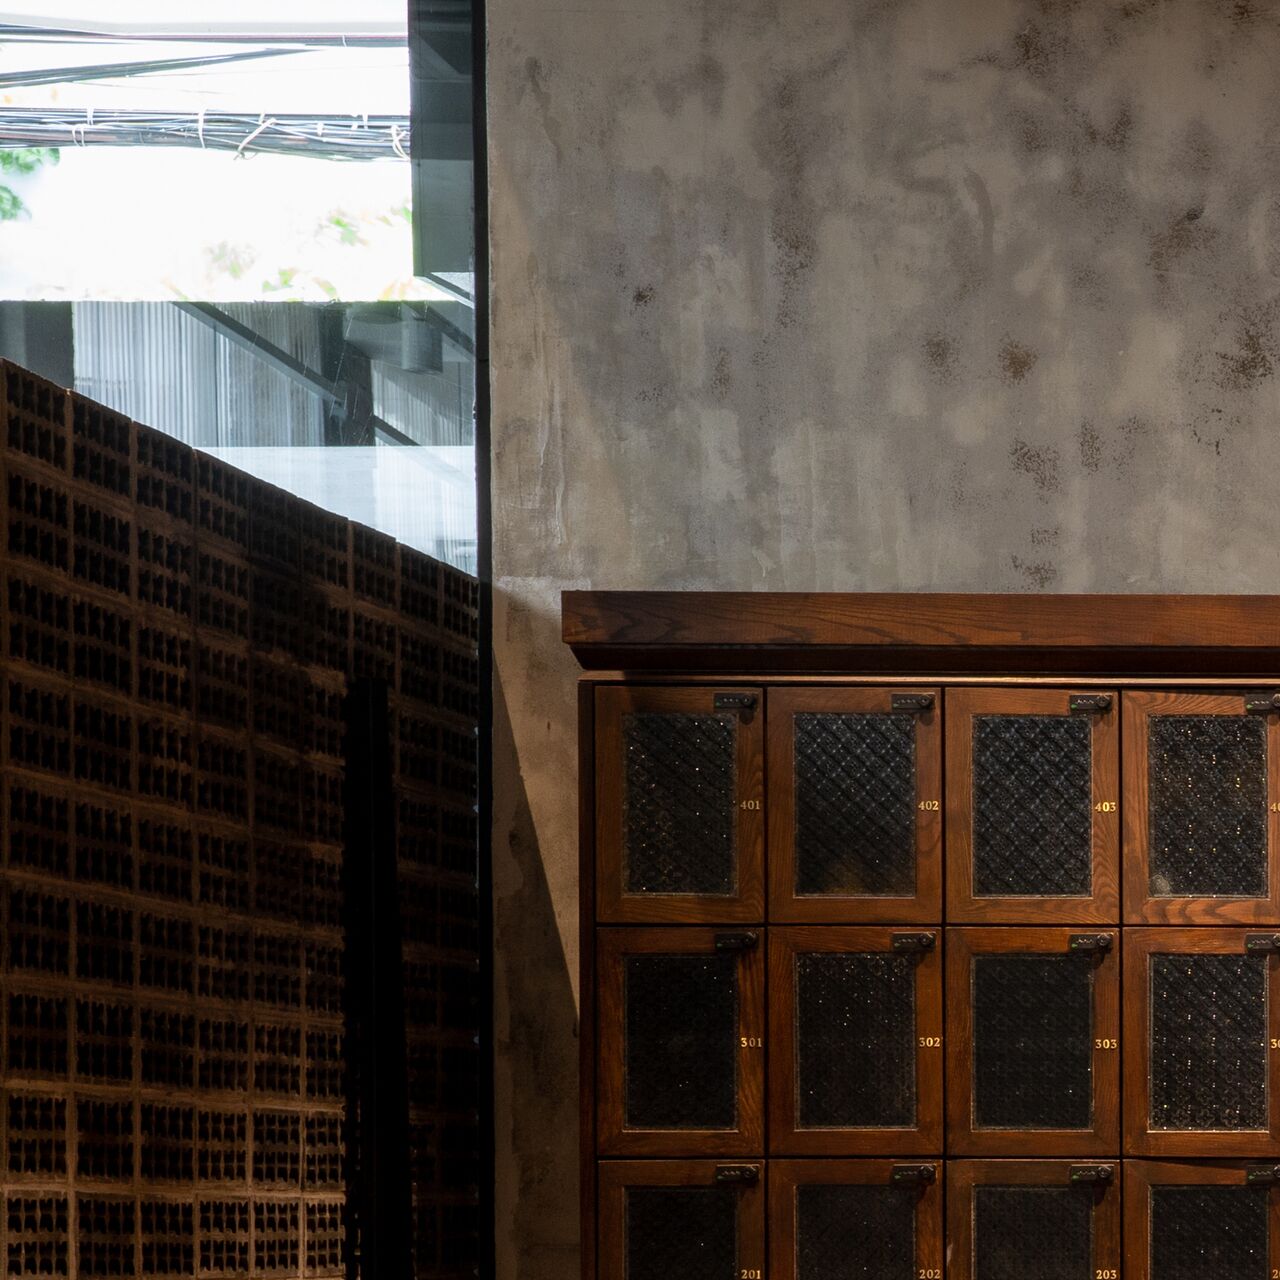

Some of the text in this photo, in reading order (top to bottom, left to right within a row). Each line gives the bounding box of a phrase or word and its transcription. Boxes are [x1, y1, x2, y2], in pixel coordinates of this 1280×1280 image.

[740, 800, 760, 810] 401
[918, 800, 939, 811] 402
[1094, 801, 1116, 812] 403
[740, 1037, 762, 1048] 301
[919, 1037, 941, 1047] 302
[1095, 1038, 1117, 1049] 303
[741, 1269, 761, 1280] 201
[919, 1268, 941, 1280] 202
[1096, 1269, 1117, 1280] 203
